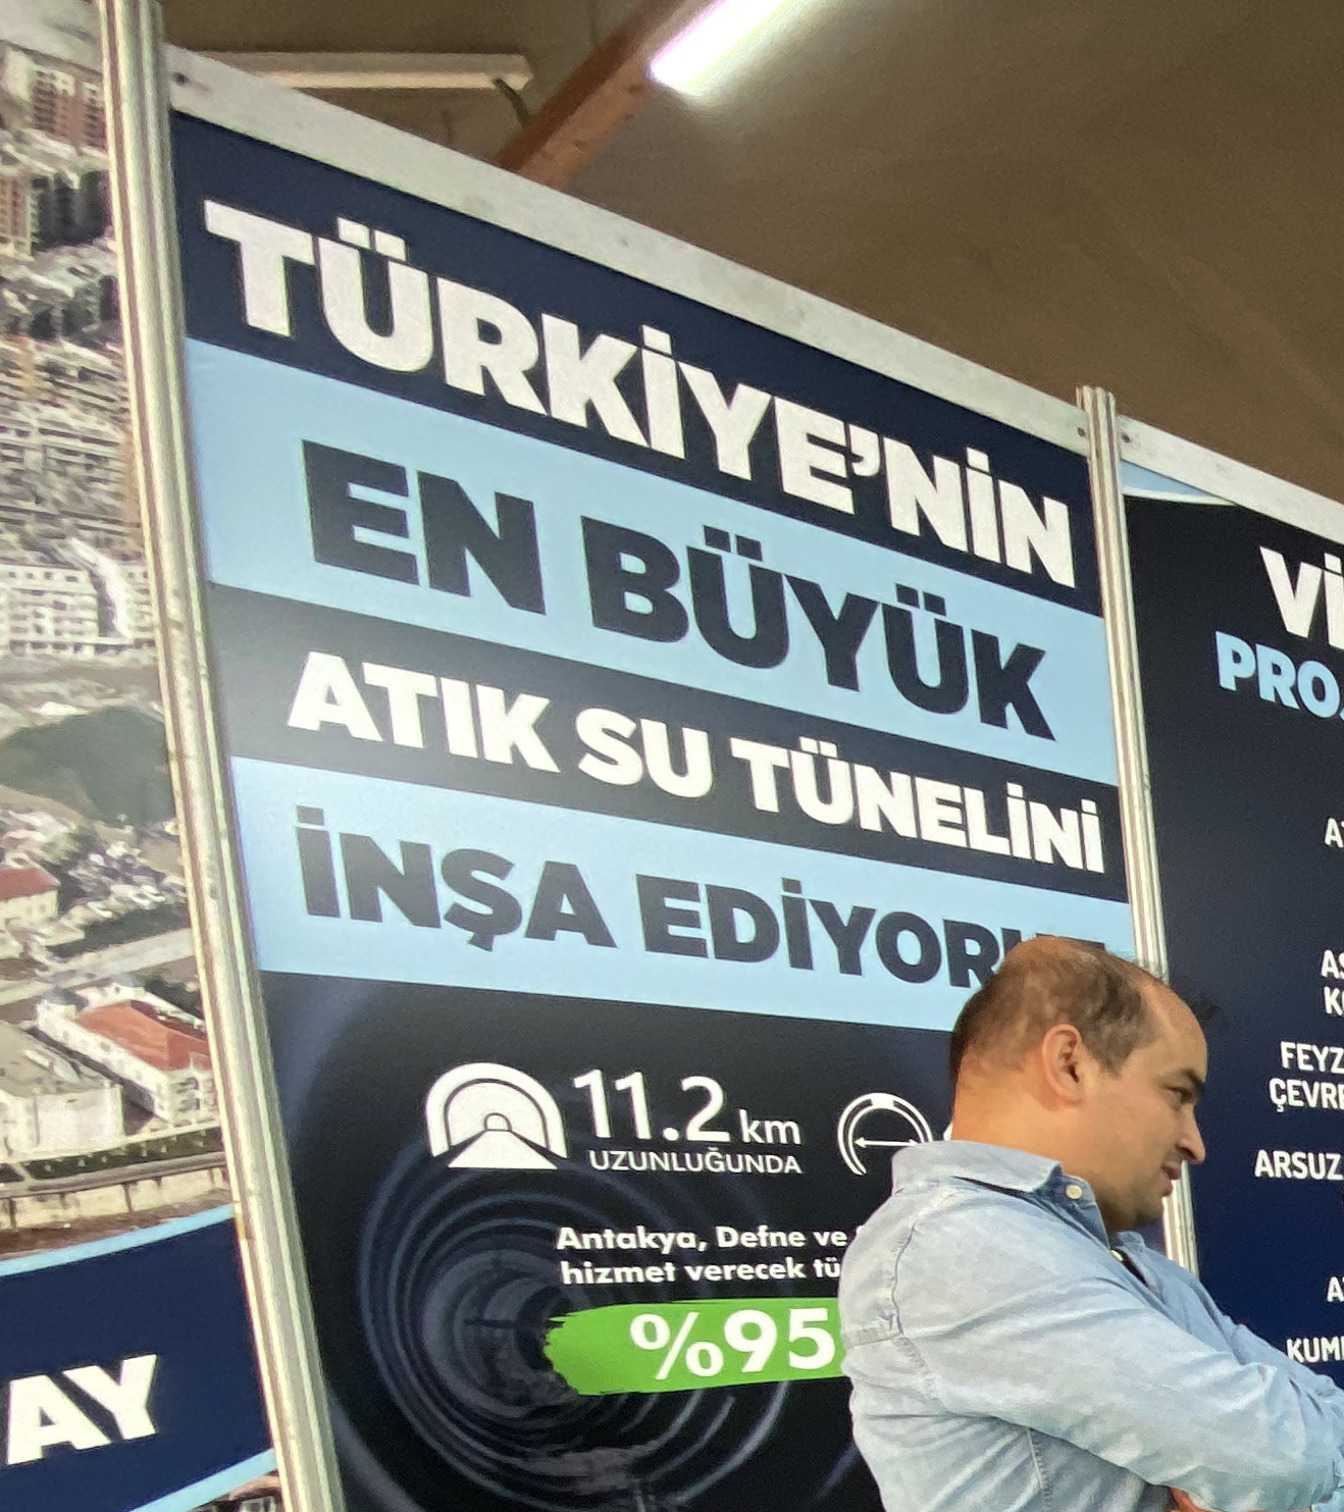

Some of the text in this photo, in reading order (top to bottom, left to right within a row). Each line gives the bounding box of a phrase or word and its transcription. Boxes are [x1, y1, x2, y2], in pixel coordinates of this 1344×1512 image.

[205, 201, 1076, 589] TÜRKİYE’NİN
[300, 440, 1058, 742] EN BÜYÜK
[286, 652, 1105, 875] ATIK SU TÜNELİNİ
[294, 806, 1106, 989] İNŞA EDİYOR
[573, 1070, 801, 1146] 11.2 km
[588, 1147, 802, 1174] UZUNLUĞUNDA
[1254, 1149, 1344, 1181] ARSUZ
[556, 1226, 708, 1254] Antakya,
[716, 1225, 807, 1250] Defne
[812, 1230, 848, 1248] ve
[560, 1260, 675, 1286] hizmet
[684, 1257, 807, 1283] verecek
[629, 1307, 837, 1381] %95
[5, 1353, 158, 1466] AY
